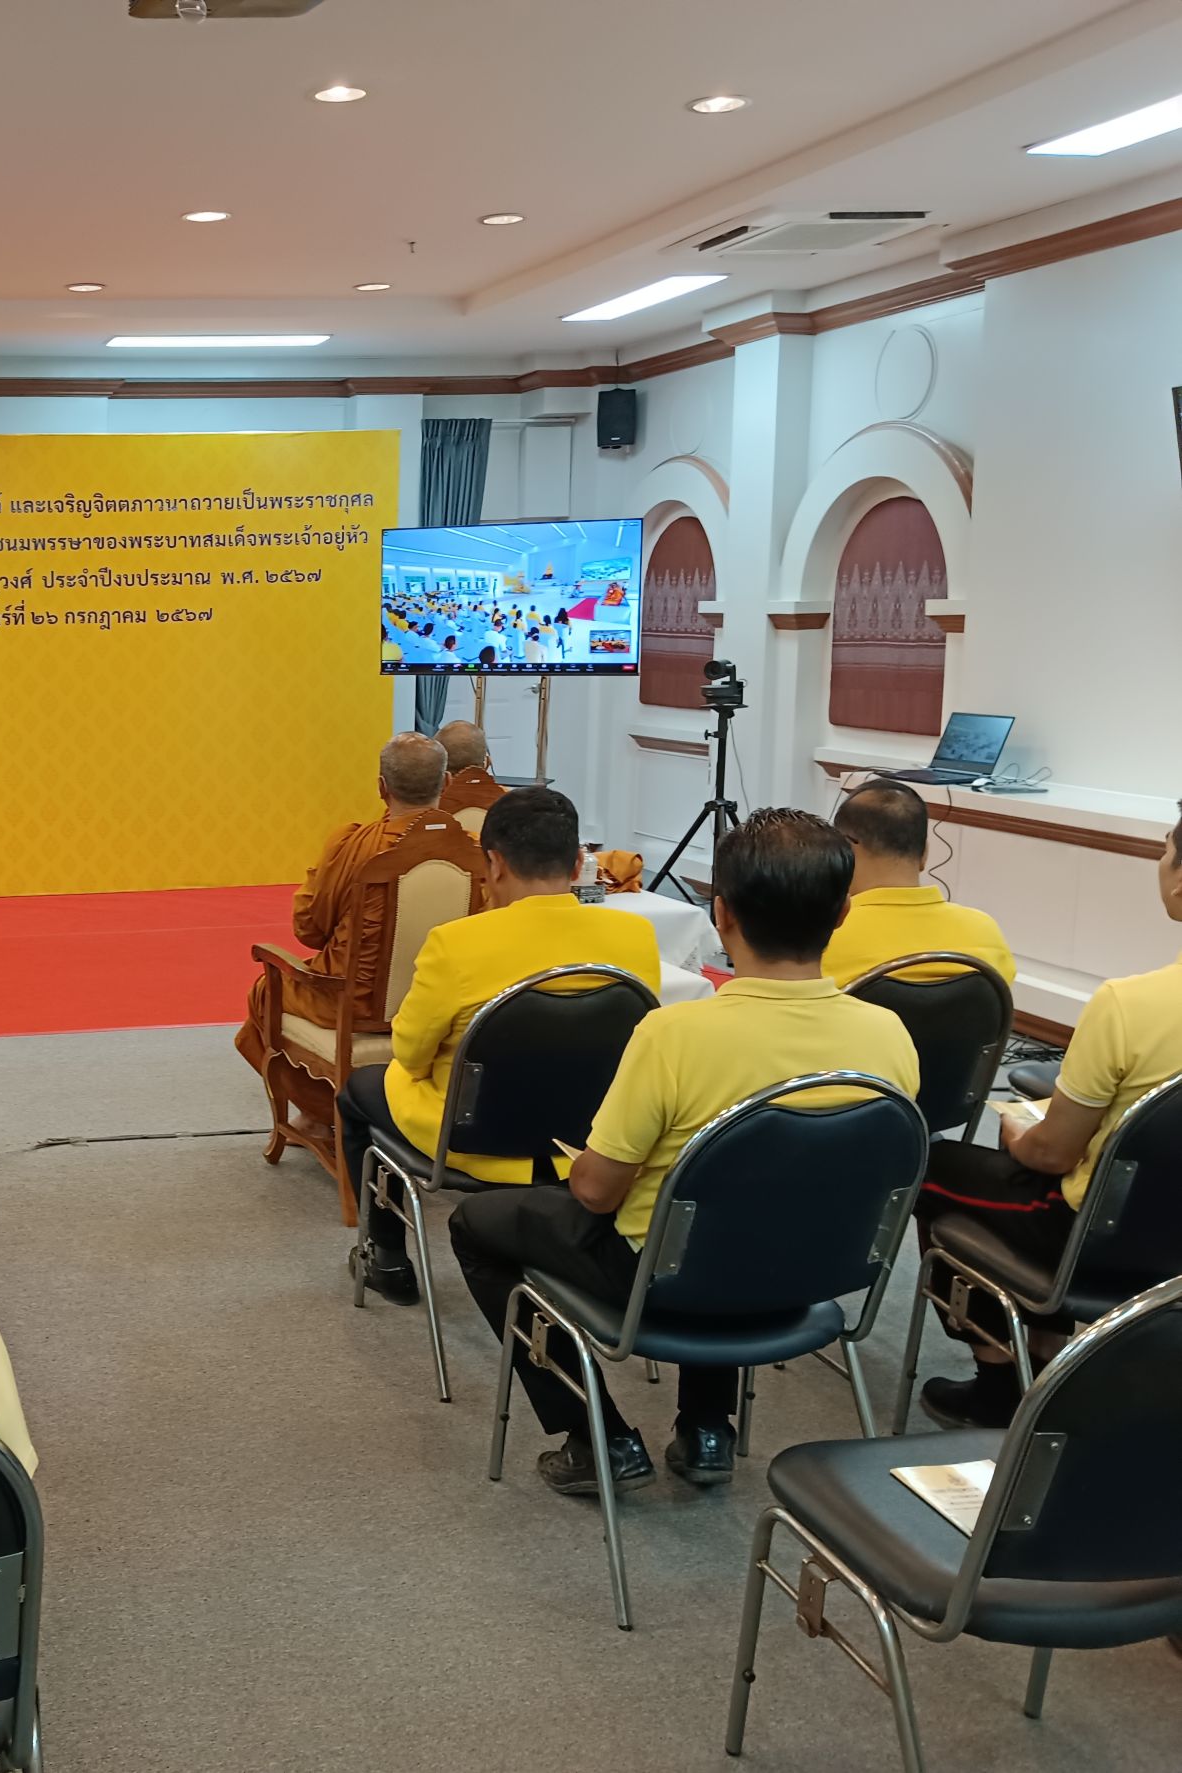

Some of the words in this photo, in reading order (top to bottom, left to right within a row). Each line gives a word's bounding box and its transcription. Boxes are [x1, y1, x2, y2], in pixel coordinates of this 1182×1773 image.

[10, 488, 374, 519] และเจริญจิตตภาวนาถวายเป็นพระราชกุศล
[41, 567, 211, 588] ประจำปีงบประมาณ
[220, 569, 260, 585] พ.ศ.
[265, 568, 322, 584] ๒๕๖๗
[30, 611, 59, 625] ๒๖
[64, 610, 147, 631] กรกฎาคม
[155, 607, 213, 623] ๒๕๖๗
